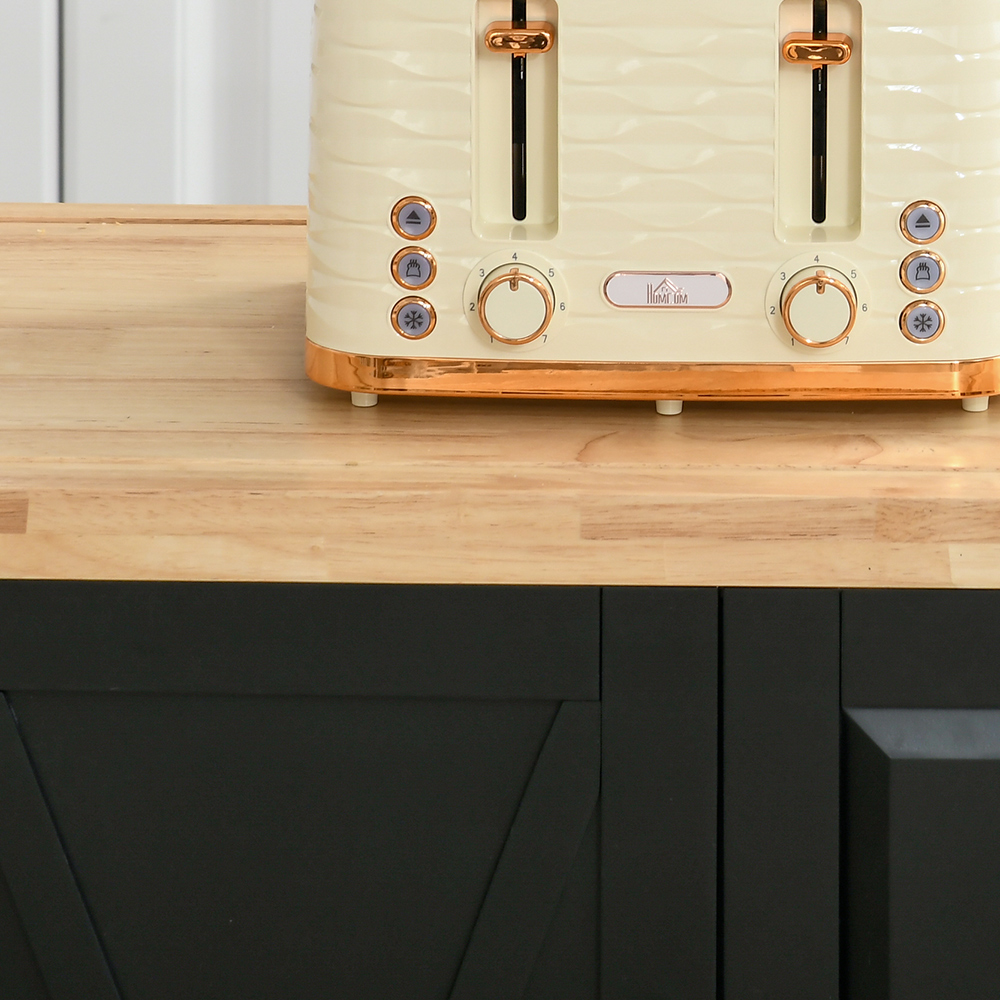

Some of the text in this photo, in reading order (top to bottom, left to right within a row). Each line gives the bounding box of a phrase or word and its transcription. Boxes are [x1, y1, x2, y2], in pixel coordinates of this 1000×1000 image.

[512, 252, 518, 261] 4
[814, 255, 820, 264] 4
[479, 268, 485, 278] 3
[548, 268, 555, 278] 5
[780, 271, 787, 281] 3
[850, 269, 857, 279] 5
[469, 302, 476, 312] 2
[559, 302, 566, 311] 6
[769, 306, 776, 315] 2
[861, 303, 868, 312] 6
[542, 334, 548, 344] 7
